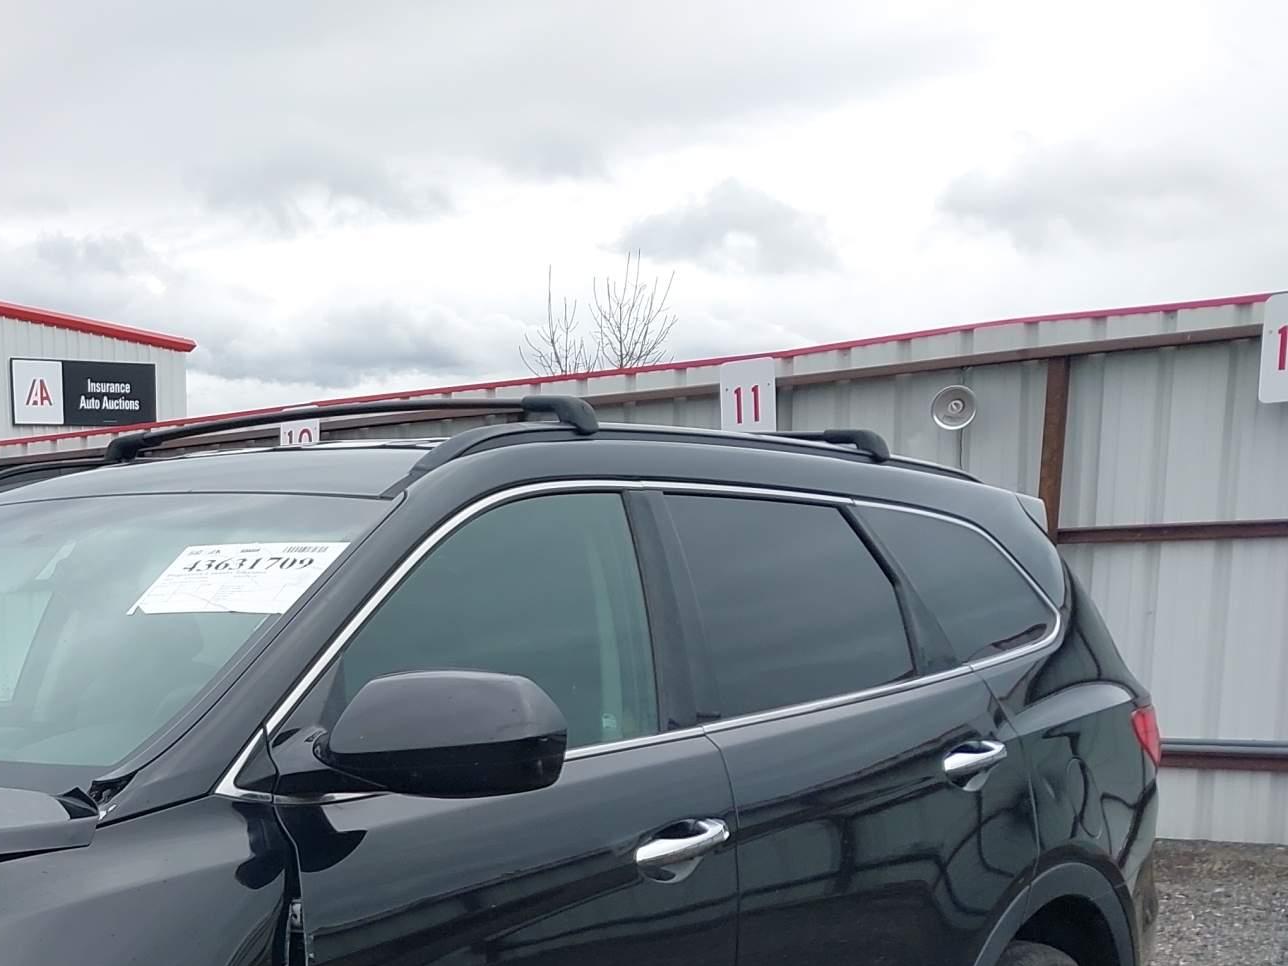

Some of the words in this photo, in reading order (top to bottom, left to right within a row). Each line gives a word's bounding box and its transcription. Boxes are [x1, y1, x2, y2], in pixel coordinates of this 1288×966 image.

[1278, 325, 1288, 370] 1
[87, 379, 131, 393] Insurance
[79, 395, 100, 410] Auto
[102, 396, 140, 411] Auctions
[734, 385, 760, 424] 11
[183, 556, 315, 573] 43631709
